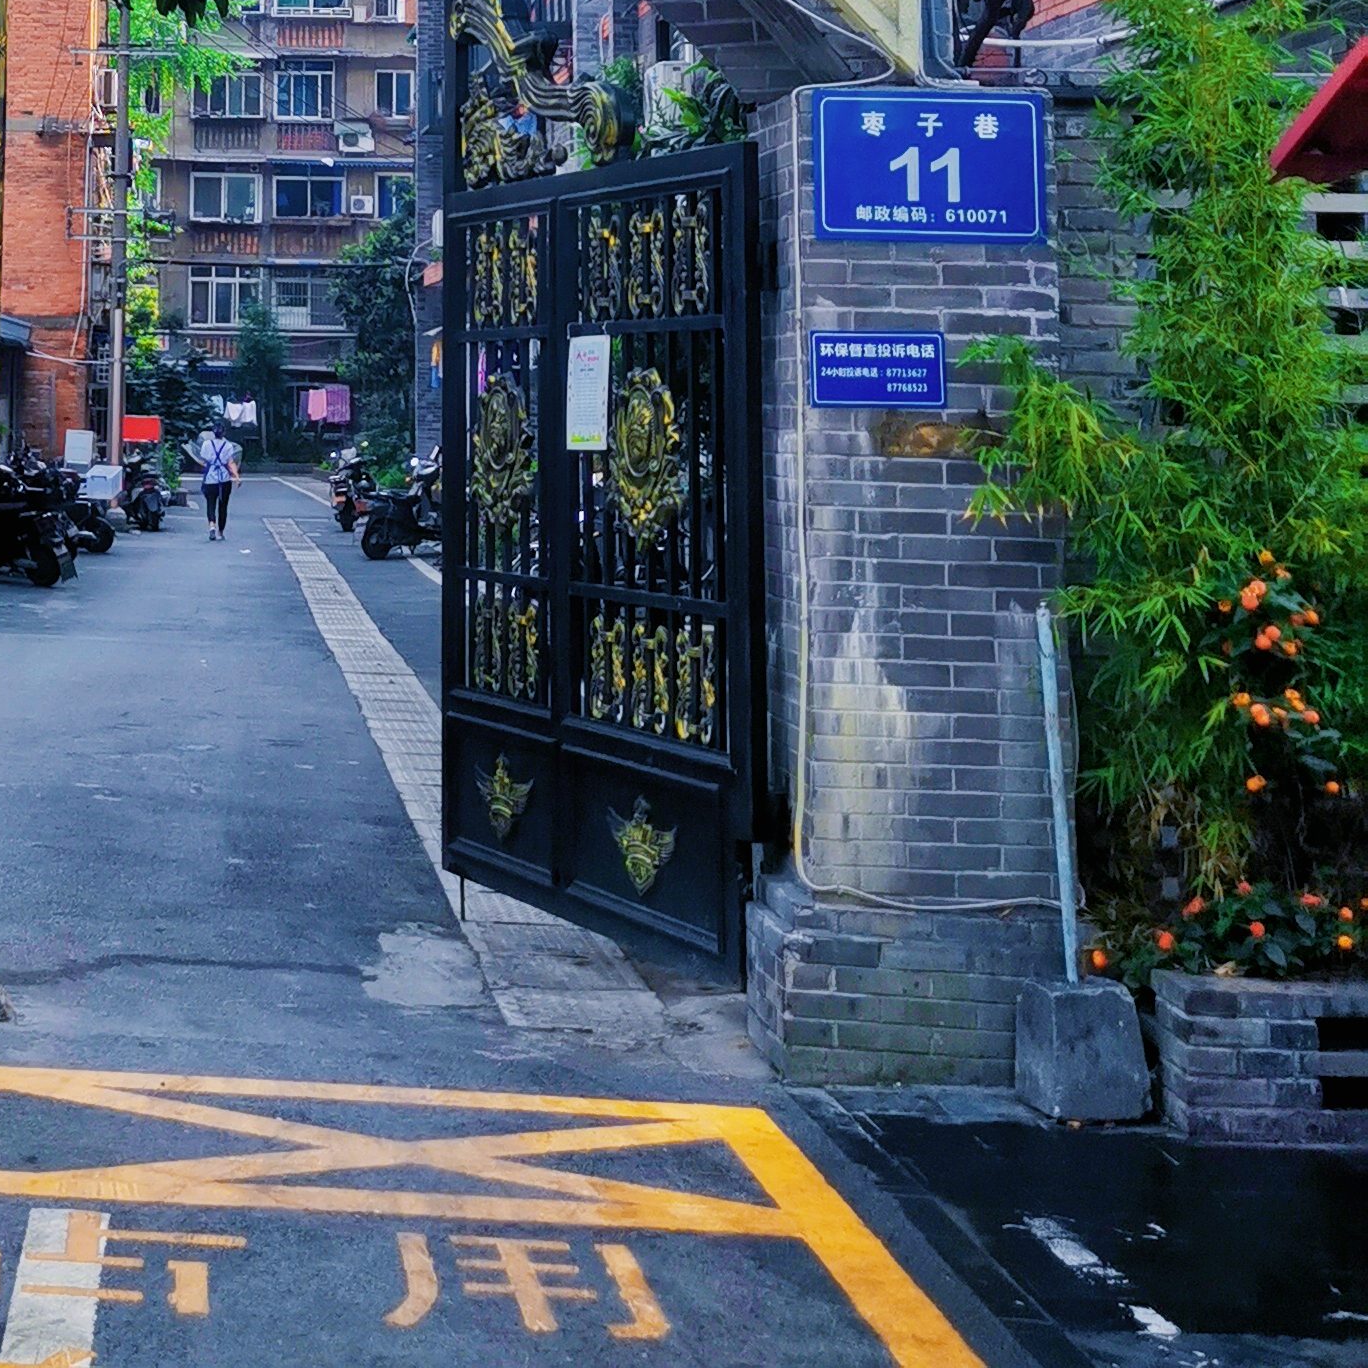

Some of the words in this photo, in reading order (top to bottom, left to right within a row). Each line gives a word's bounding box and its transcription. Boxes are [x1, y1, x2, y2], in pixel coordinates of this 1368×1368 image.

[861, 110, 1000, 140] 枣子巷
[889, 145, 962, 204] 11
[855, 204, 1008, 225] 邮政编码：610071
[819, 342, 935, 359] 环保督查投诉电话
